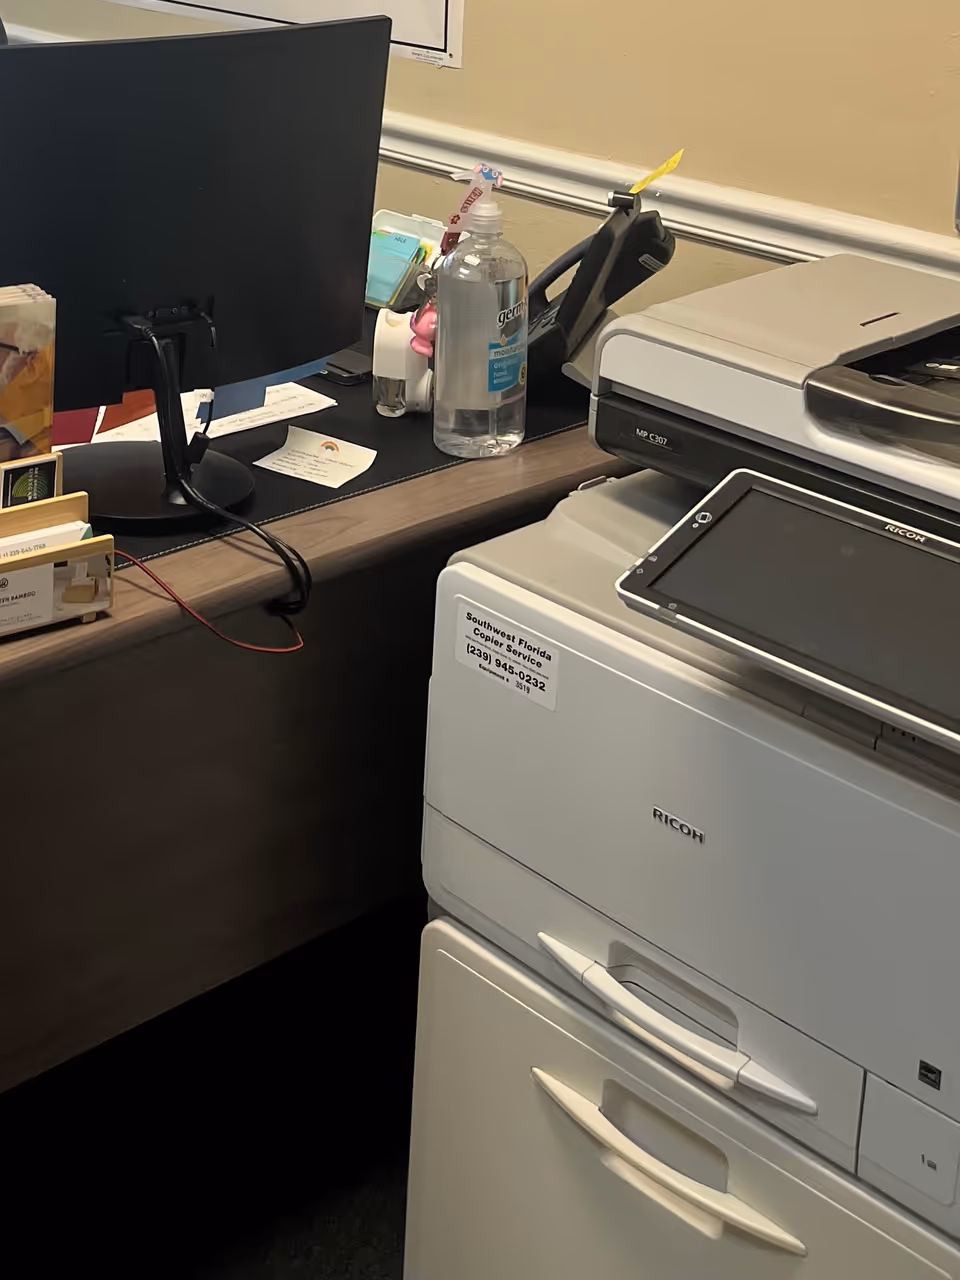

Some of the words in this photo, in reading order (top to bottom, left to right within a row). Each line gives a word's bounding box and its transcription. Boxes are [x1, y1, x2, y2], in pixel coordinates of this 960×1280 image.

[460, 186, 483, 213] STITCH
[635, 428, 648, 438] MP
[649, 433, 667, 445] C307
[884, 524, 926, 543] RICOH
[466, 612, 515, 643] Southwest
[518, 638, 552, 662] Florida
[473, 627, 504, 648] Copier
[505, 644, 543, 668] Service
[466, 642, 492, 665] (239)
[495, 658, 546, 692] 945-0232
[652, 807, 704, 844] RICOH
